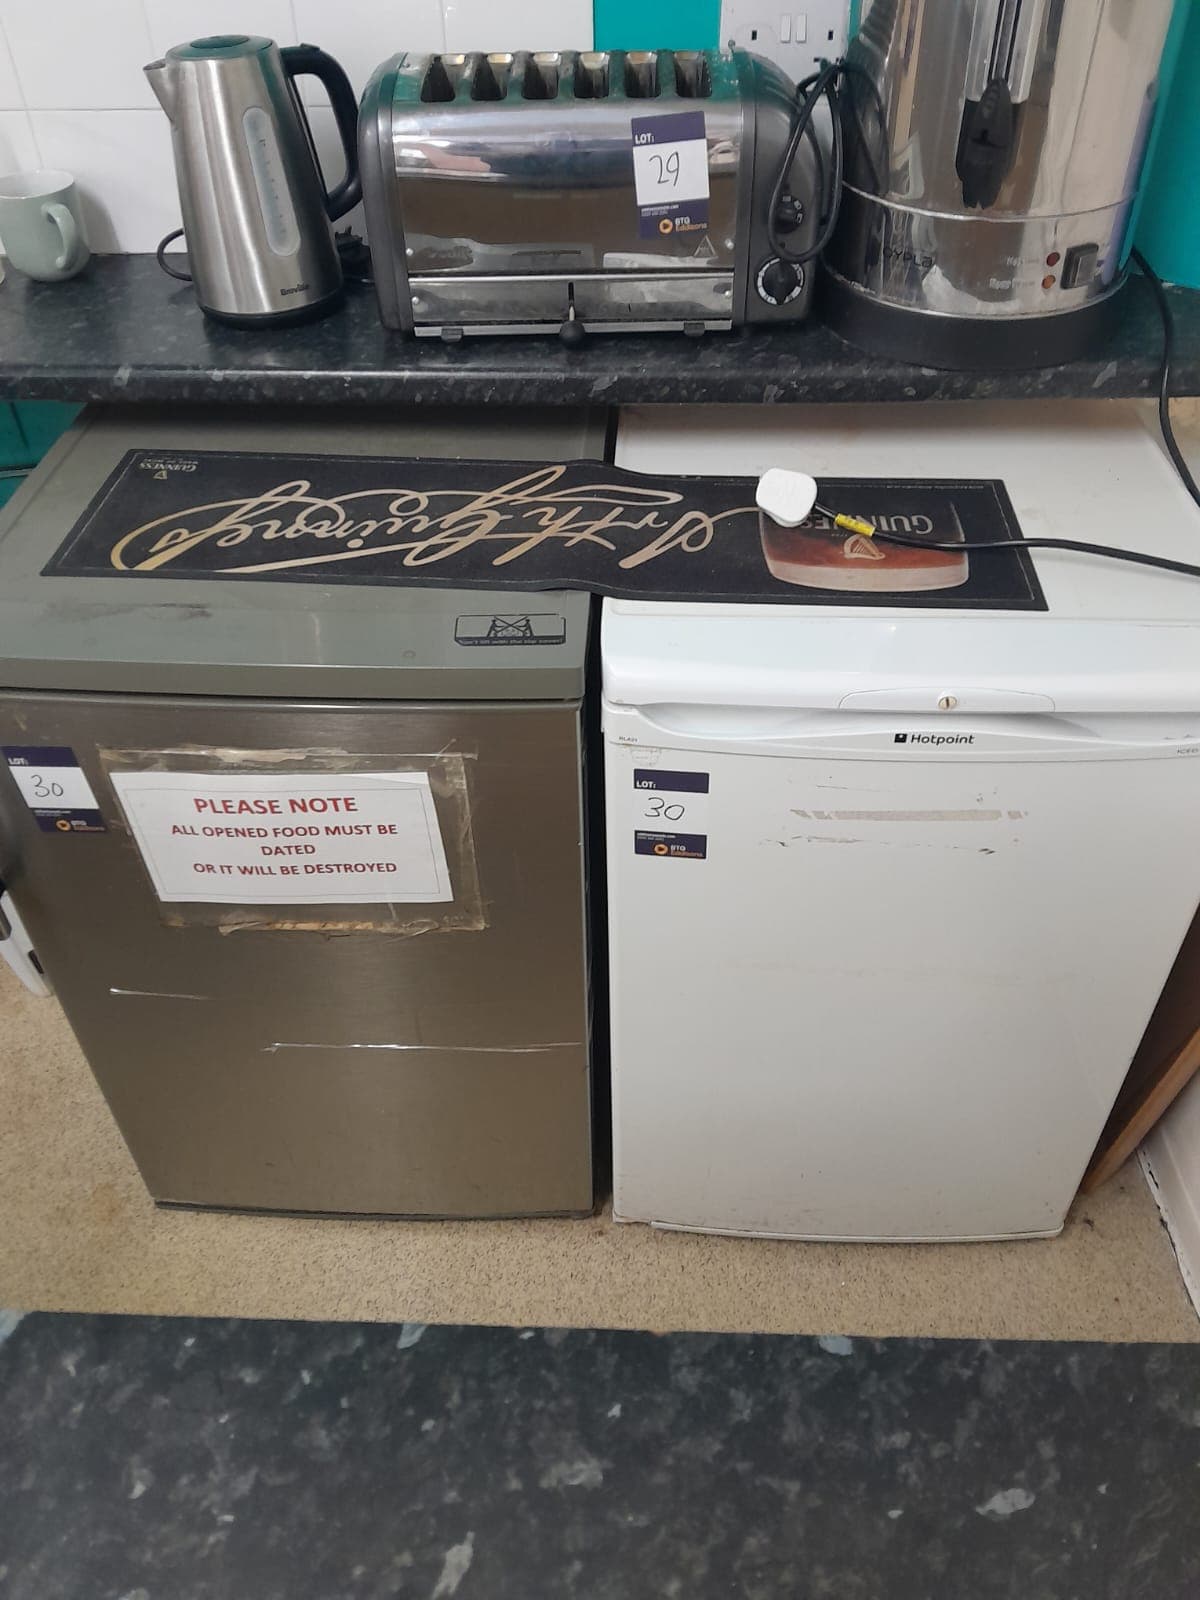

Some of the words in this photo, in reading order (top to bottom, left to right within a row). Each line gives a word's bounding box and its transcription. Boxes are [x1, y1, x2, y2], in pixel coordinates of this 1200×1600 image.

[649, 151, 680, 187] 29
[911, 733, 975, 745] Hotpoint
[31, 774, 64, 798] 30
[636, 780, 656, 789] LOT:
[193, 797, 283, 815] PLEASE
[288, 796, 358, 814] NOTE
[644, 796, 685, 821] 30
[171, 824, 199, 836] ALL
[202, 825, 269, 838] OPENED
[272, 825, 320, 838] FOOD
[325, 824, 373, 836] MUST
[377, 823, 398, 835] BE
[260, 844, 316, 857] DATED
[193, 862, 216, 874] OR
[220, 863, 234, 875] IT
[237, 863, 277, 876] WILL
[280, 863, 300, 875] BE
[303, 862, 398, 874] DESTROYED
